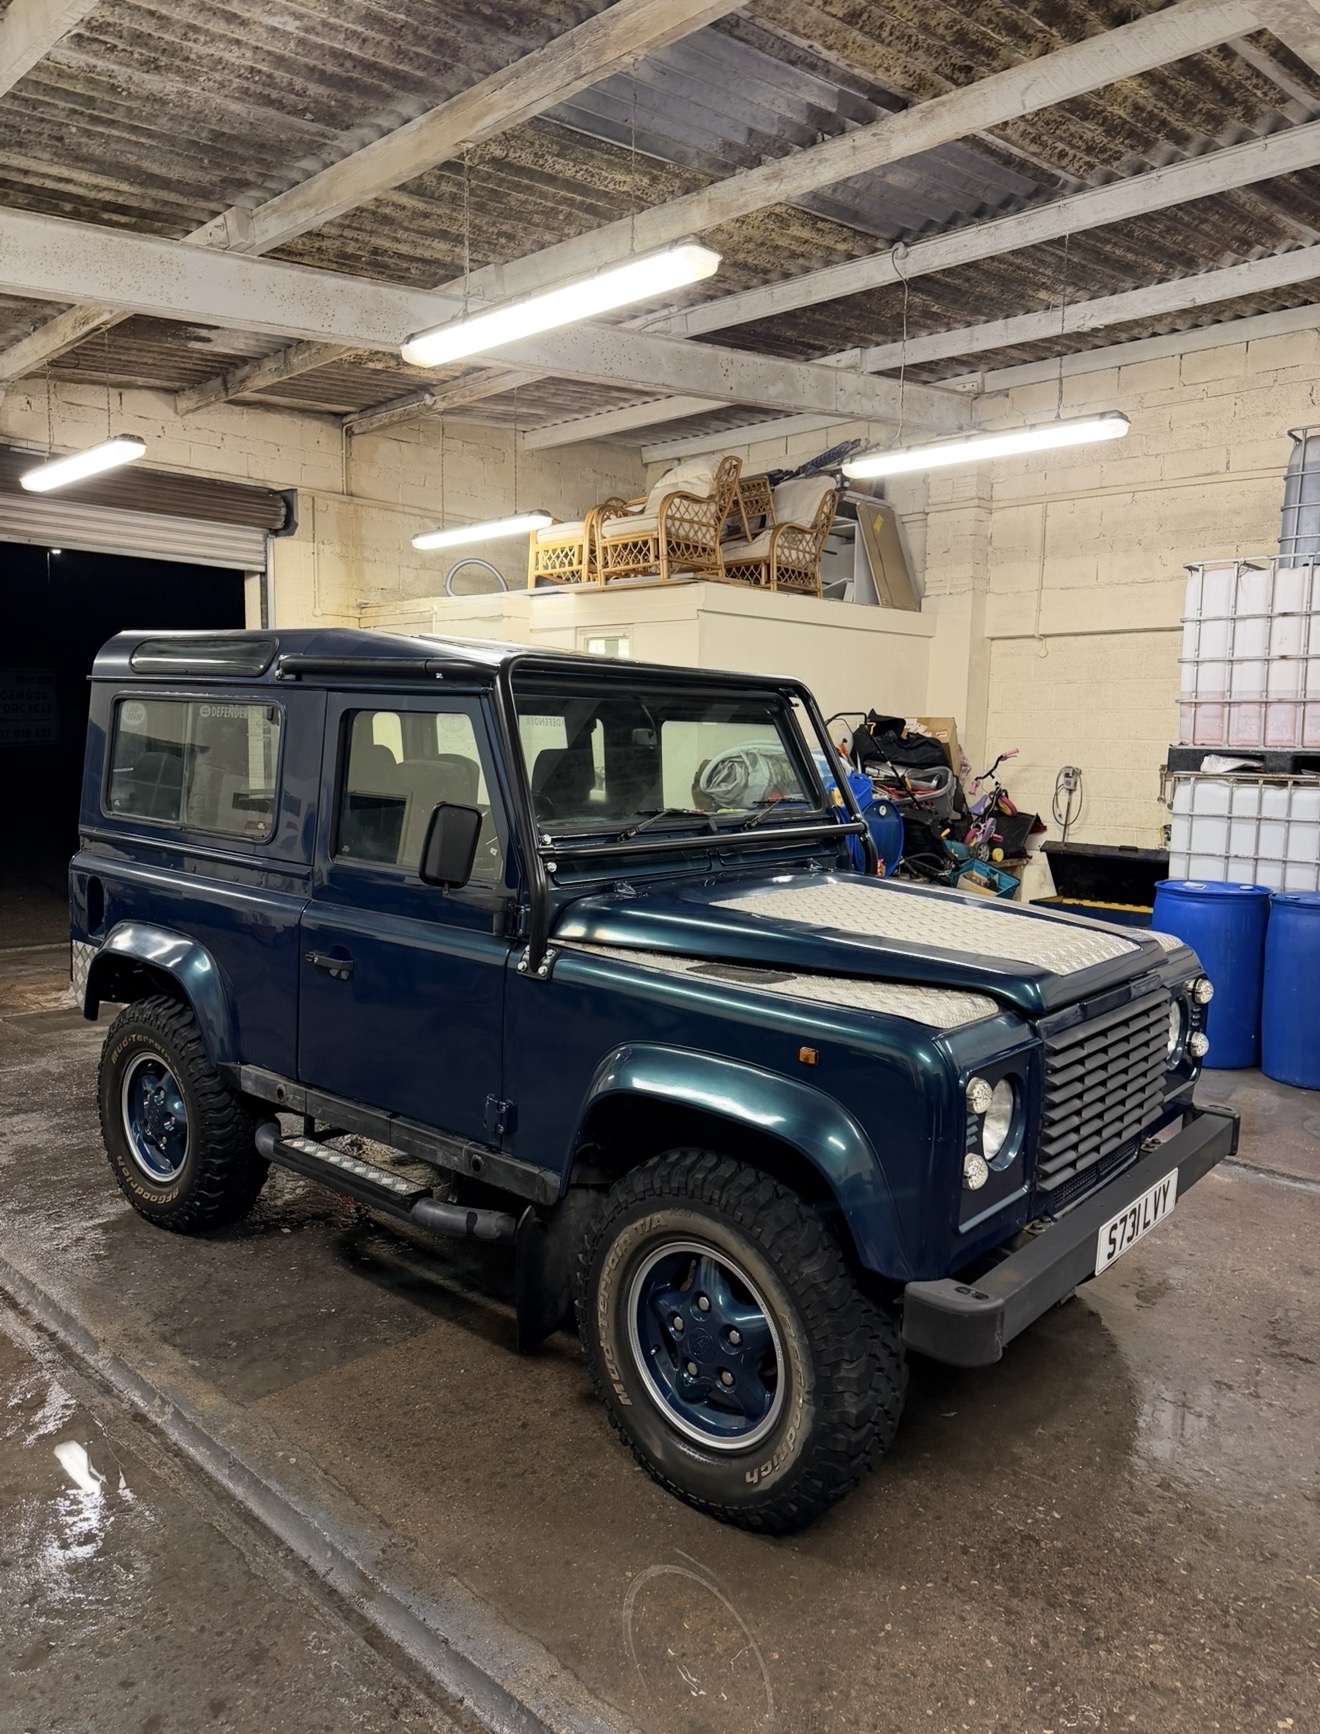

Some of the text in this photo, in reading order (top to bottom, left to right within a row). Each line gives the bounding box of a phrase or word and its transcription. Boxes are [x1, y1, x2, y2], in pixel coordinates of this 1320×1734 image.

[211, 705, 248, 719] DEFENDER
[116, 1155, 180, 1205] BFGoodrich
[633, 1212, 668, 1238] T/A
